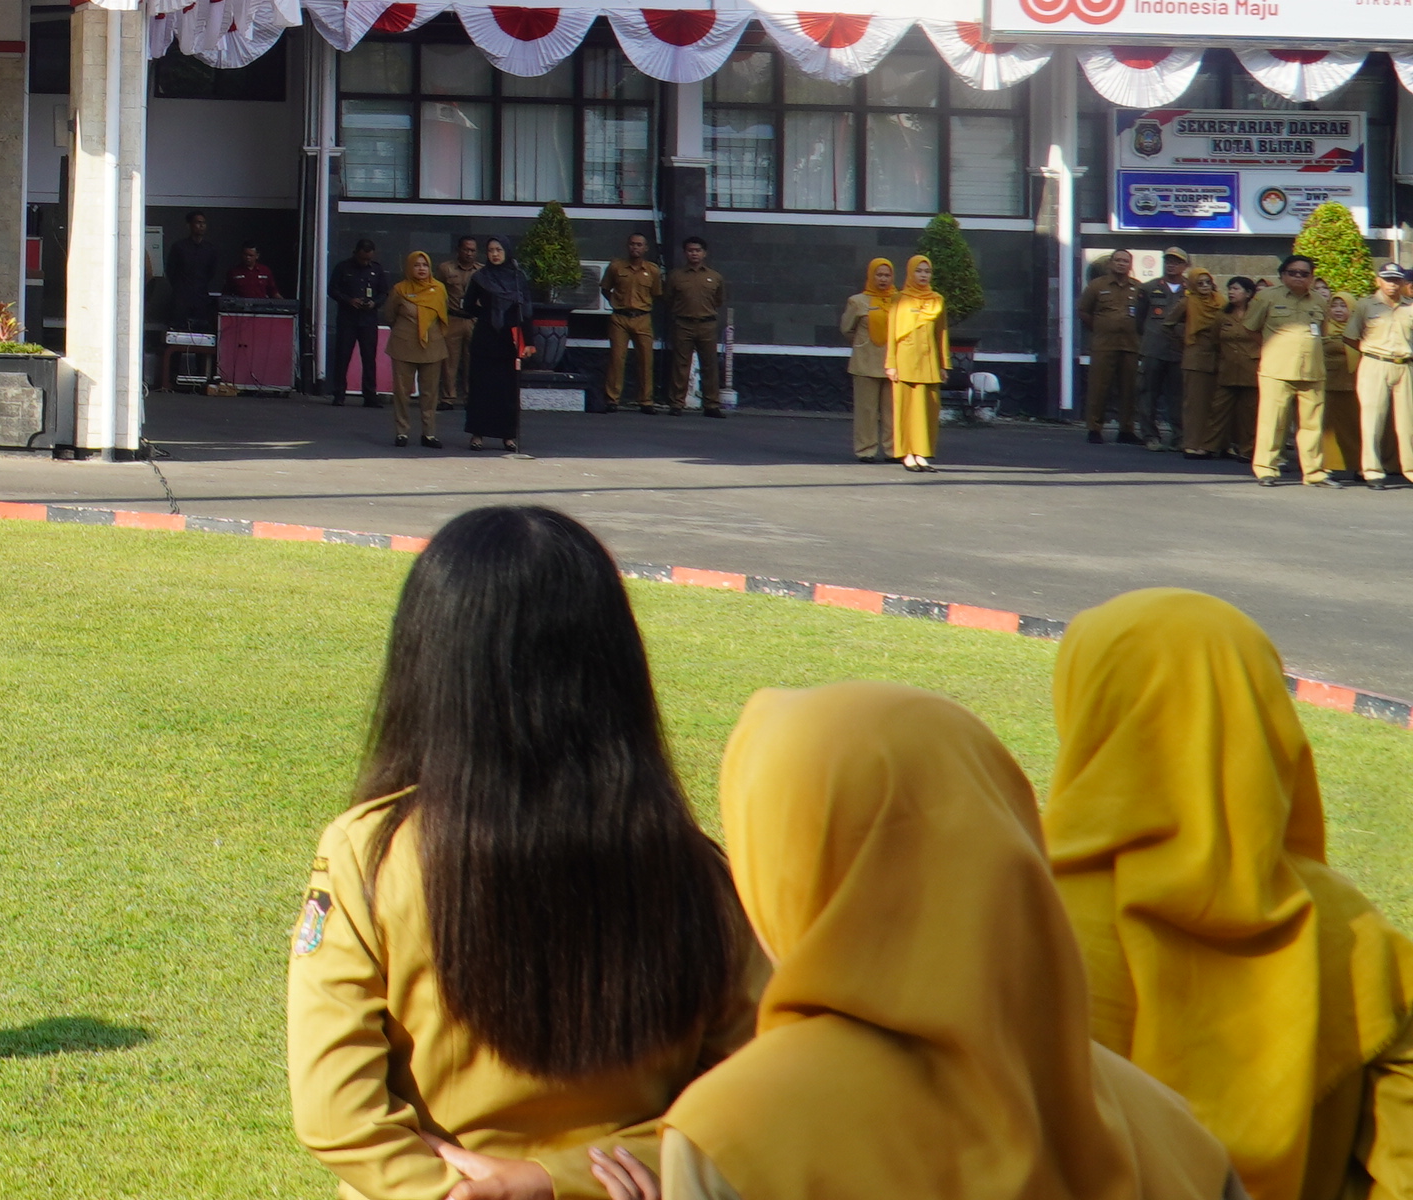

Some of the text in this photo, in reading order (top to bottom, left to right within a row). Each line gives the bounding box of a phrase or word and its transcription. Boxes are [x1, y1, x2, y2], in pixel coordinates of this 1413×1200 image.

[1176, 119, 1350, 136] SEKRETARIAT DAERAH
[1212, 138, 1315, 154] KOTA BLITAR
[1174, 194, 1214, 203] KORPRI
